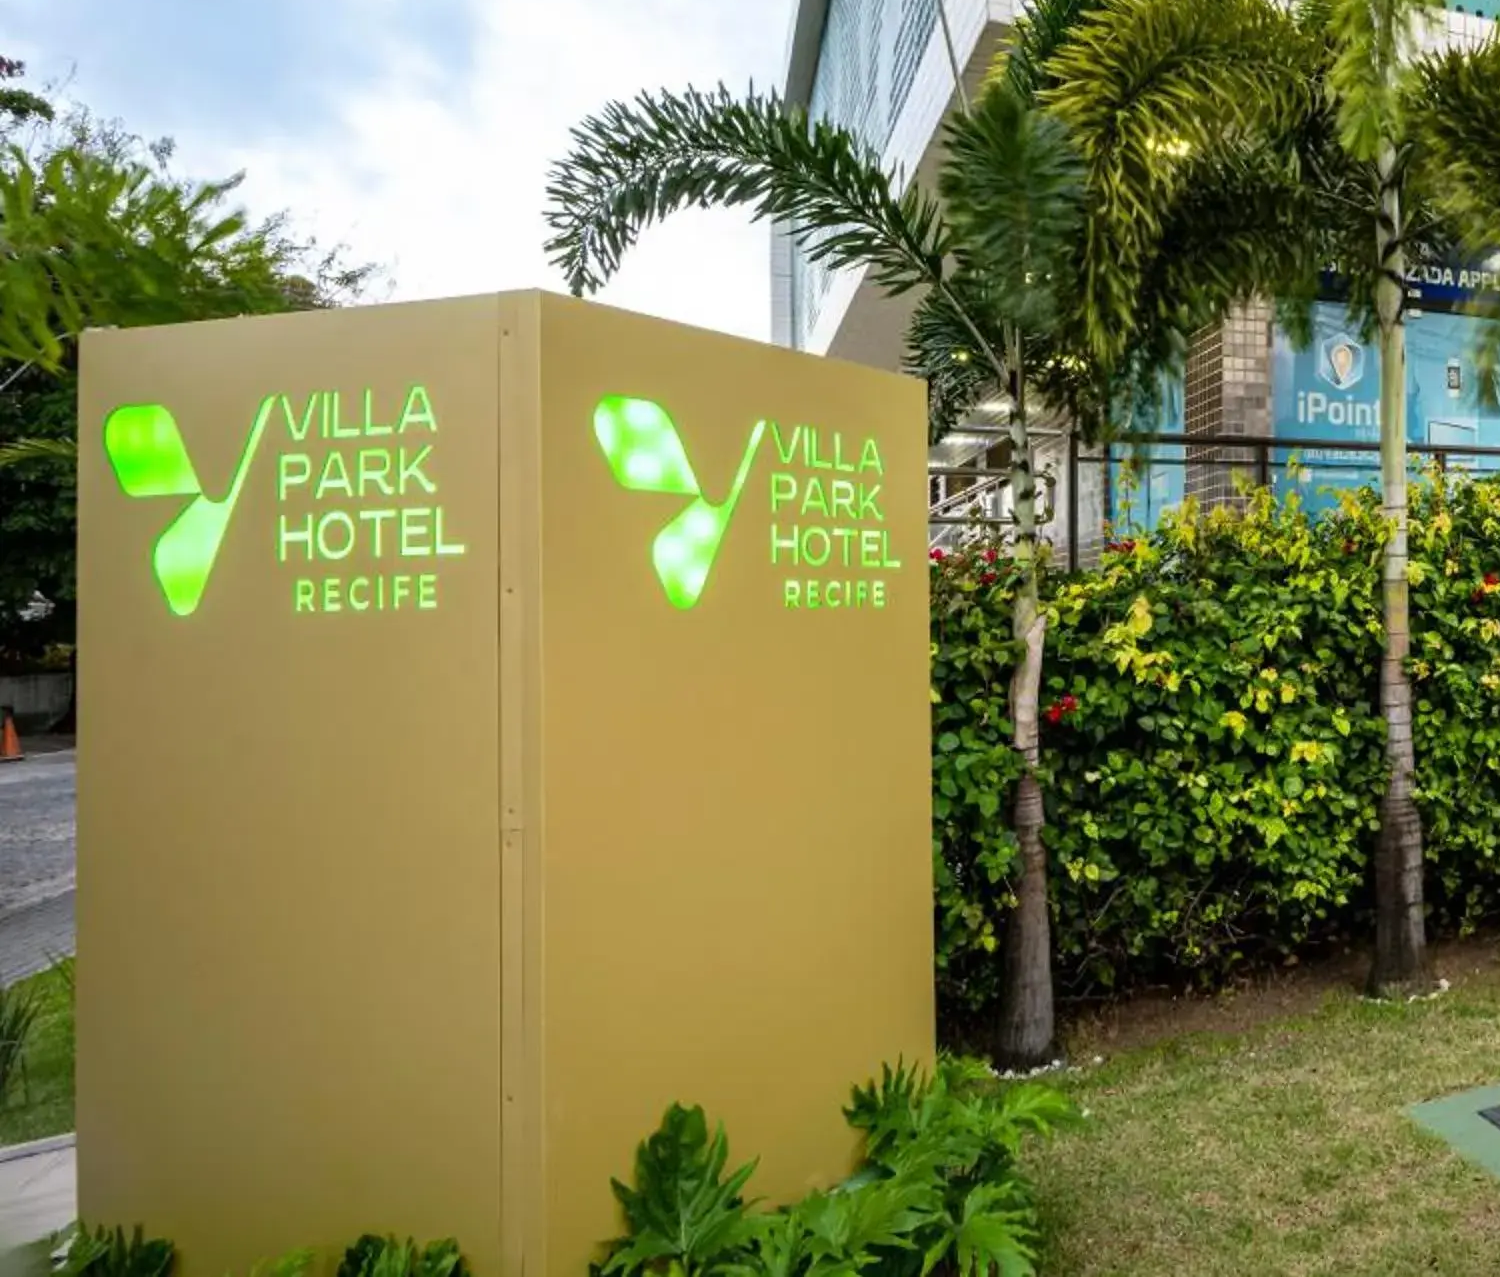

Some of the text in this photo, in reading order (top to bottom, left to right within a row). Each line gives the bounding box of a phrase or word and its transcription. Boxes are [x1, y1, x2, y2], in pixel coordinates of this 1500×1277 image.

[279, 385, 438, 441] VILLA
[278, 445, 438, 501] PARK
[771, 422, 885, 476] VILLA
[771, 473, 885, 521] PARK
[277, 506, 466, 562] HOTEL
[771, 523, 902, 569] HOTEL
[294, 574, 438, 613] RECIFE
[783, 579, 887, 608] RECIFE
